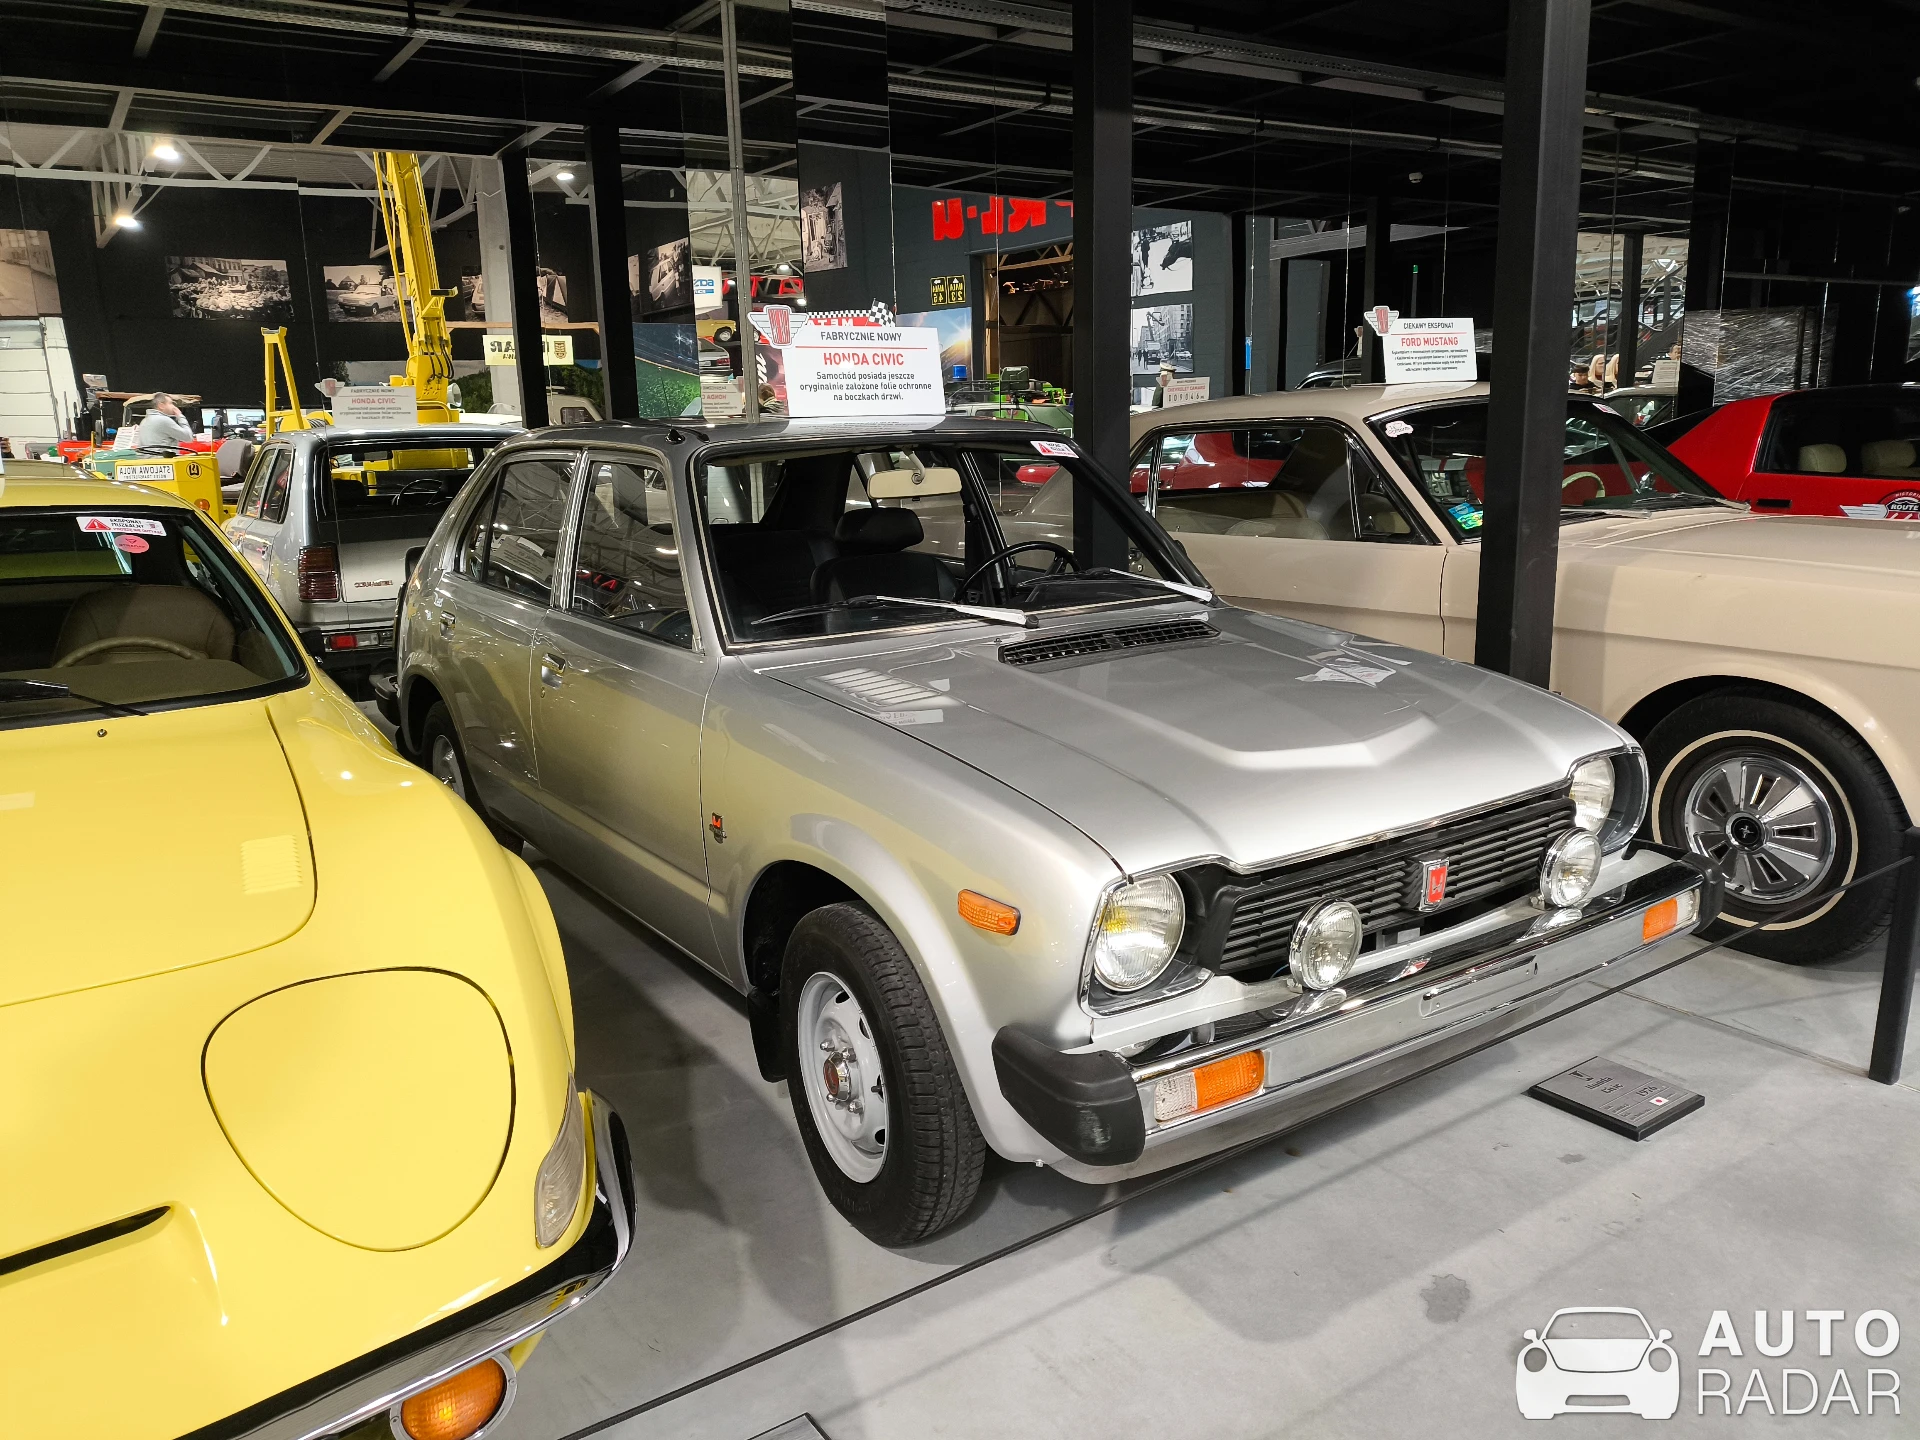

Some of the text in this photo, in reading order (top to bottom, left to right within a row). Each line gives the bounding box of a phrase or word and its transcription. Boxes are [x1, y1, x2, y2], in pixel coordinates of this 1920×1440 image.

[820, 331, 902, 341] FABRYCZNIE NOWY
[1401, 337, 1458, 347] FORD MUSTANG
[823, 352, 904, 366] HONDA CIVIC
[816, 371, 915, 382] Samochód posiada jeszcze
[800, 382, 844, 392] oryginalnie
[880, 382, 897, 390] folie
[898, 382, 932, 390] ochronne
[844, 392, 880, 401] boczkach
[881, 392, 904, 400] drzwi.
